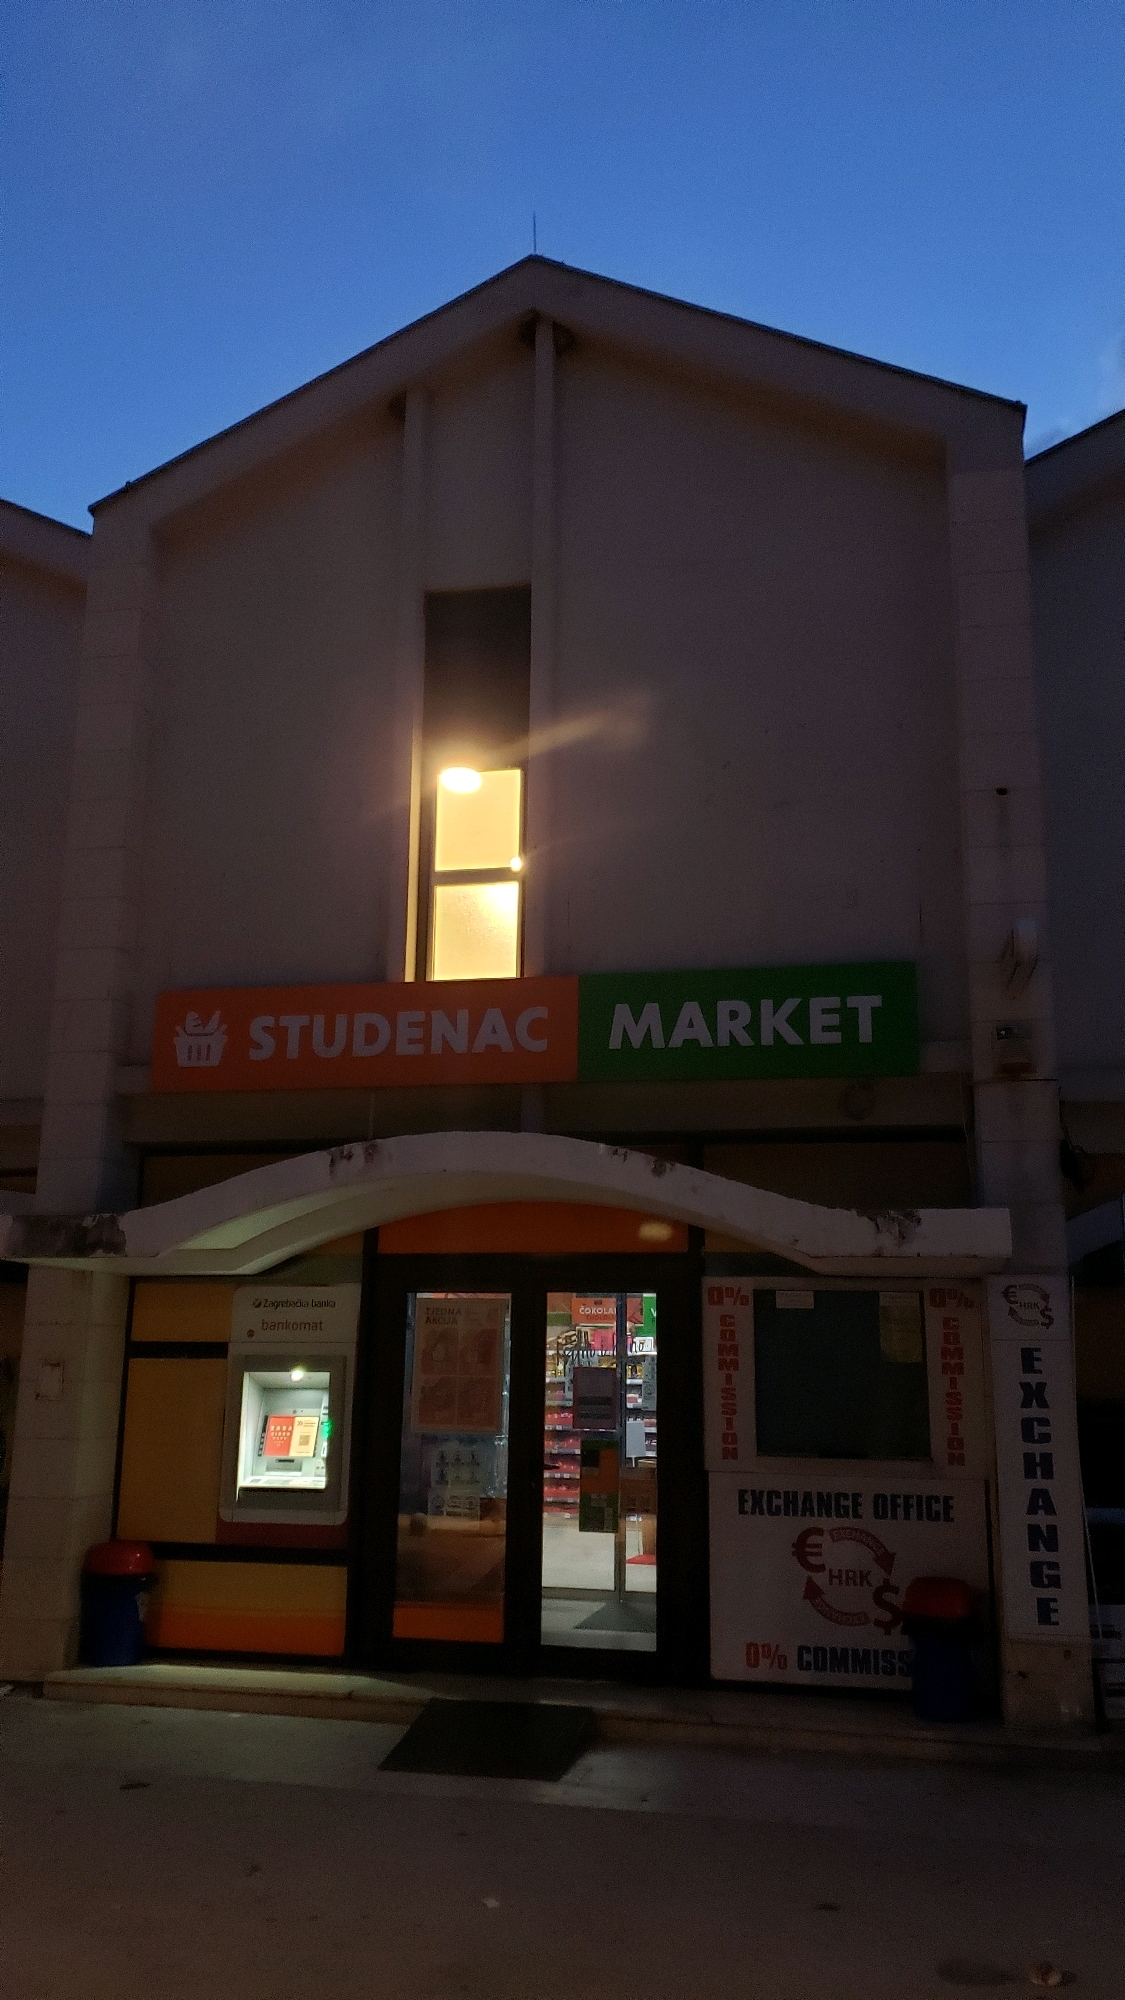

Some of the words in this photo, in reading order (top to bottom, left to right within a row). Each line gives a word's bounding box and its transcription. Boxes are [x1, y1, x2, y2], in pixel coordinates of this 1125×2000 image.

[248, 1005, 549, 1060] STUDENAC
[607, 994, 883, 1051] MARKET
[263, 1298, 309, 1309] Zagrebačka
[311, 1298, 336, 1308] banka
[707, 1286, 750, 1307] 0%
[929, 1288, 975, 1309] 0%
[261, 1319, 324, 1331] bankomat
[717, 1314, 739, 1460] COMMISSION
[941, 1316, 966, 1466] COMMISSION
[1020, 1347, 1062, 1626] EXCHANGE
[738, 1489, 864, 1520] EXCHANGE
[873, 1493, 955, 1522] OFFICE
[828, 1569, 873, 1588] HRK
[745, 1642, 788, 1670] 0%
[797, 1645, 913, 1677] COMMISS
